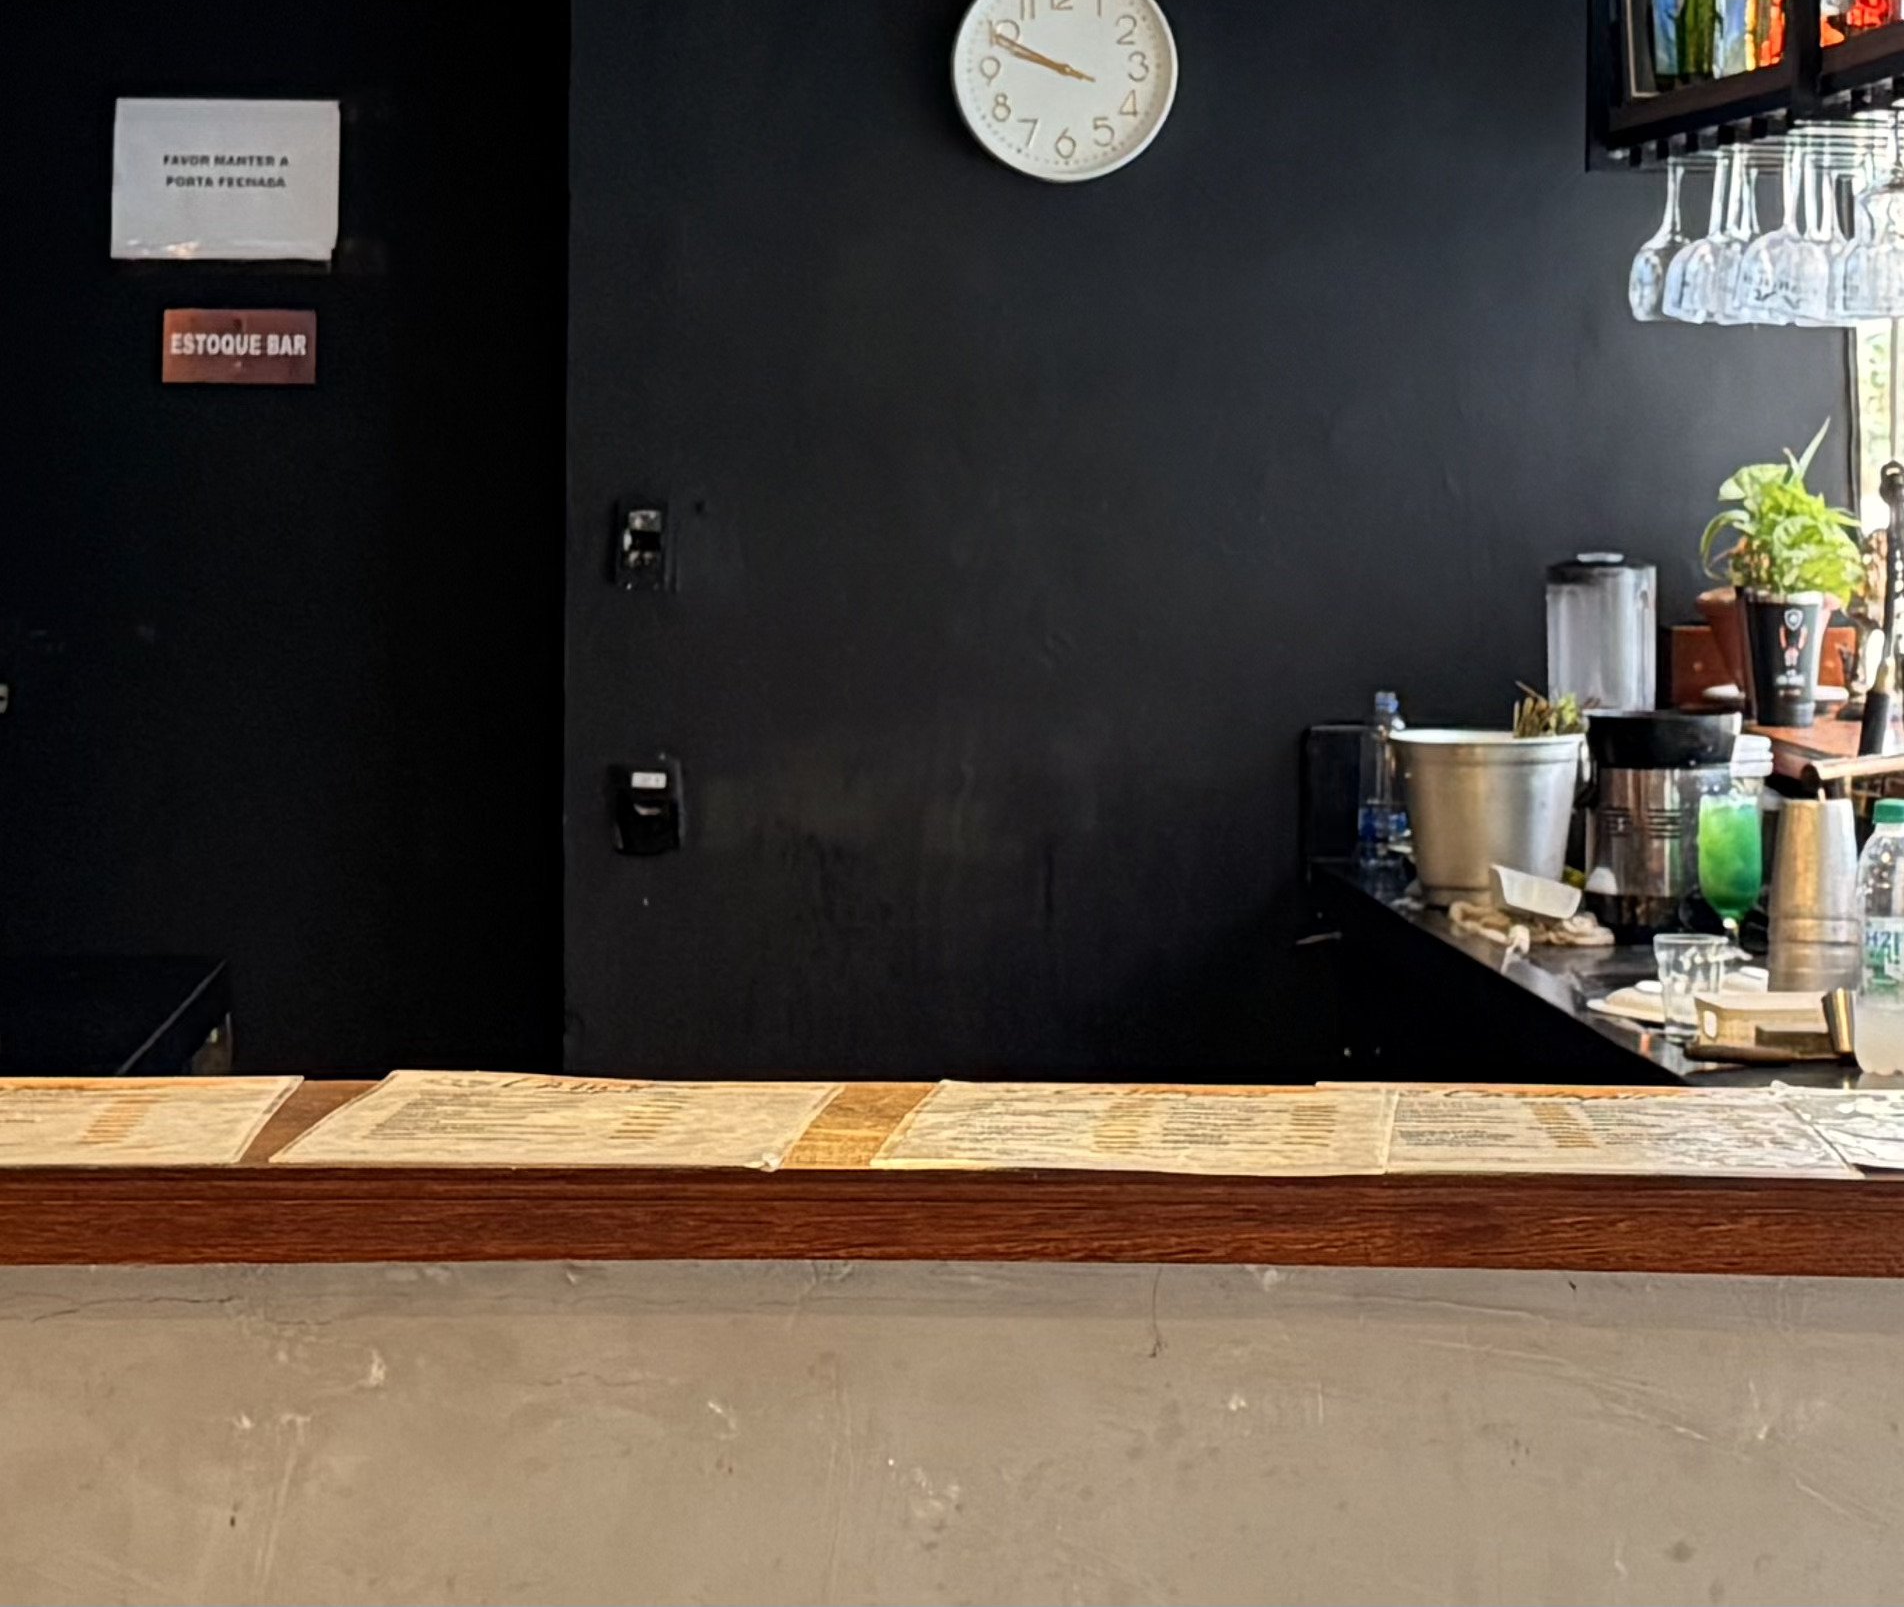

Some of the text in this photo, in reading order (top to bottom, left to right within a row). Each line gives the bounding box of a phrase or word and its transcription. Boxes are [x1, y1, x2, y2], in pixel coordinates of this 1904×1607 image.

[1115, 14, 1138, 45] 2
[978, 56, 1002, 87] 9
[1127, 50, 1150, 83] 3
[992, 93, 1012, 123] 8
[1118, 89, 1139, 118] 4
[1016, 118, 1039, 148] 7
[1054, 127, 1078, 160] 6
[1092, 116, 1116, 148] 5
[163, 155, 290, 167] FAVOR MANTER A
[166, 176, 287, 188] PORTA FECHADA
[170, 333, 308, 357] ESTOQUE BAR
